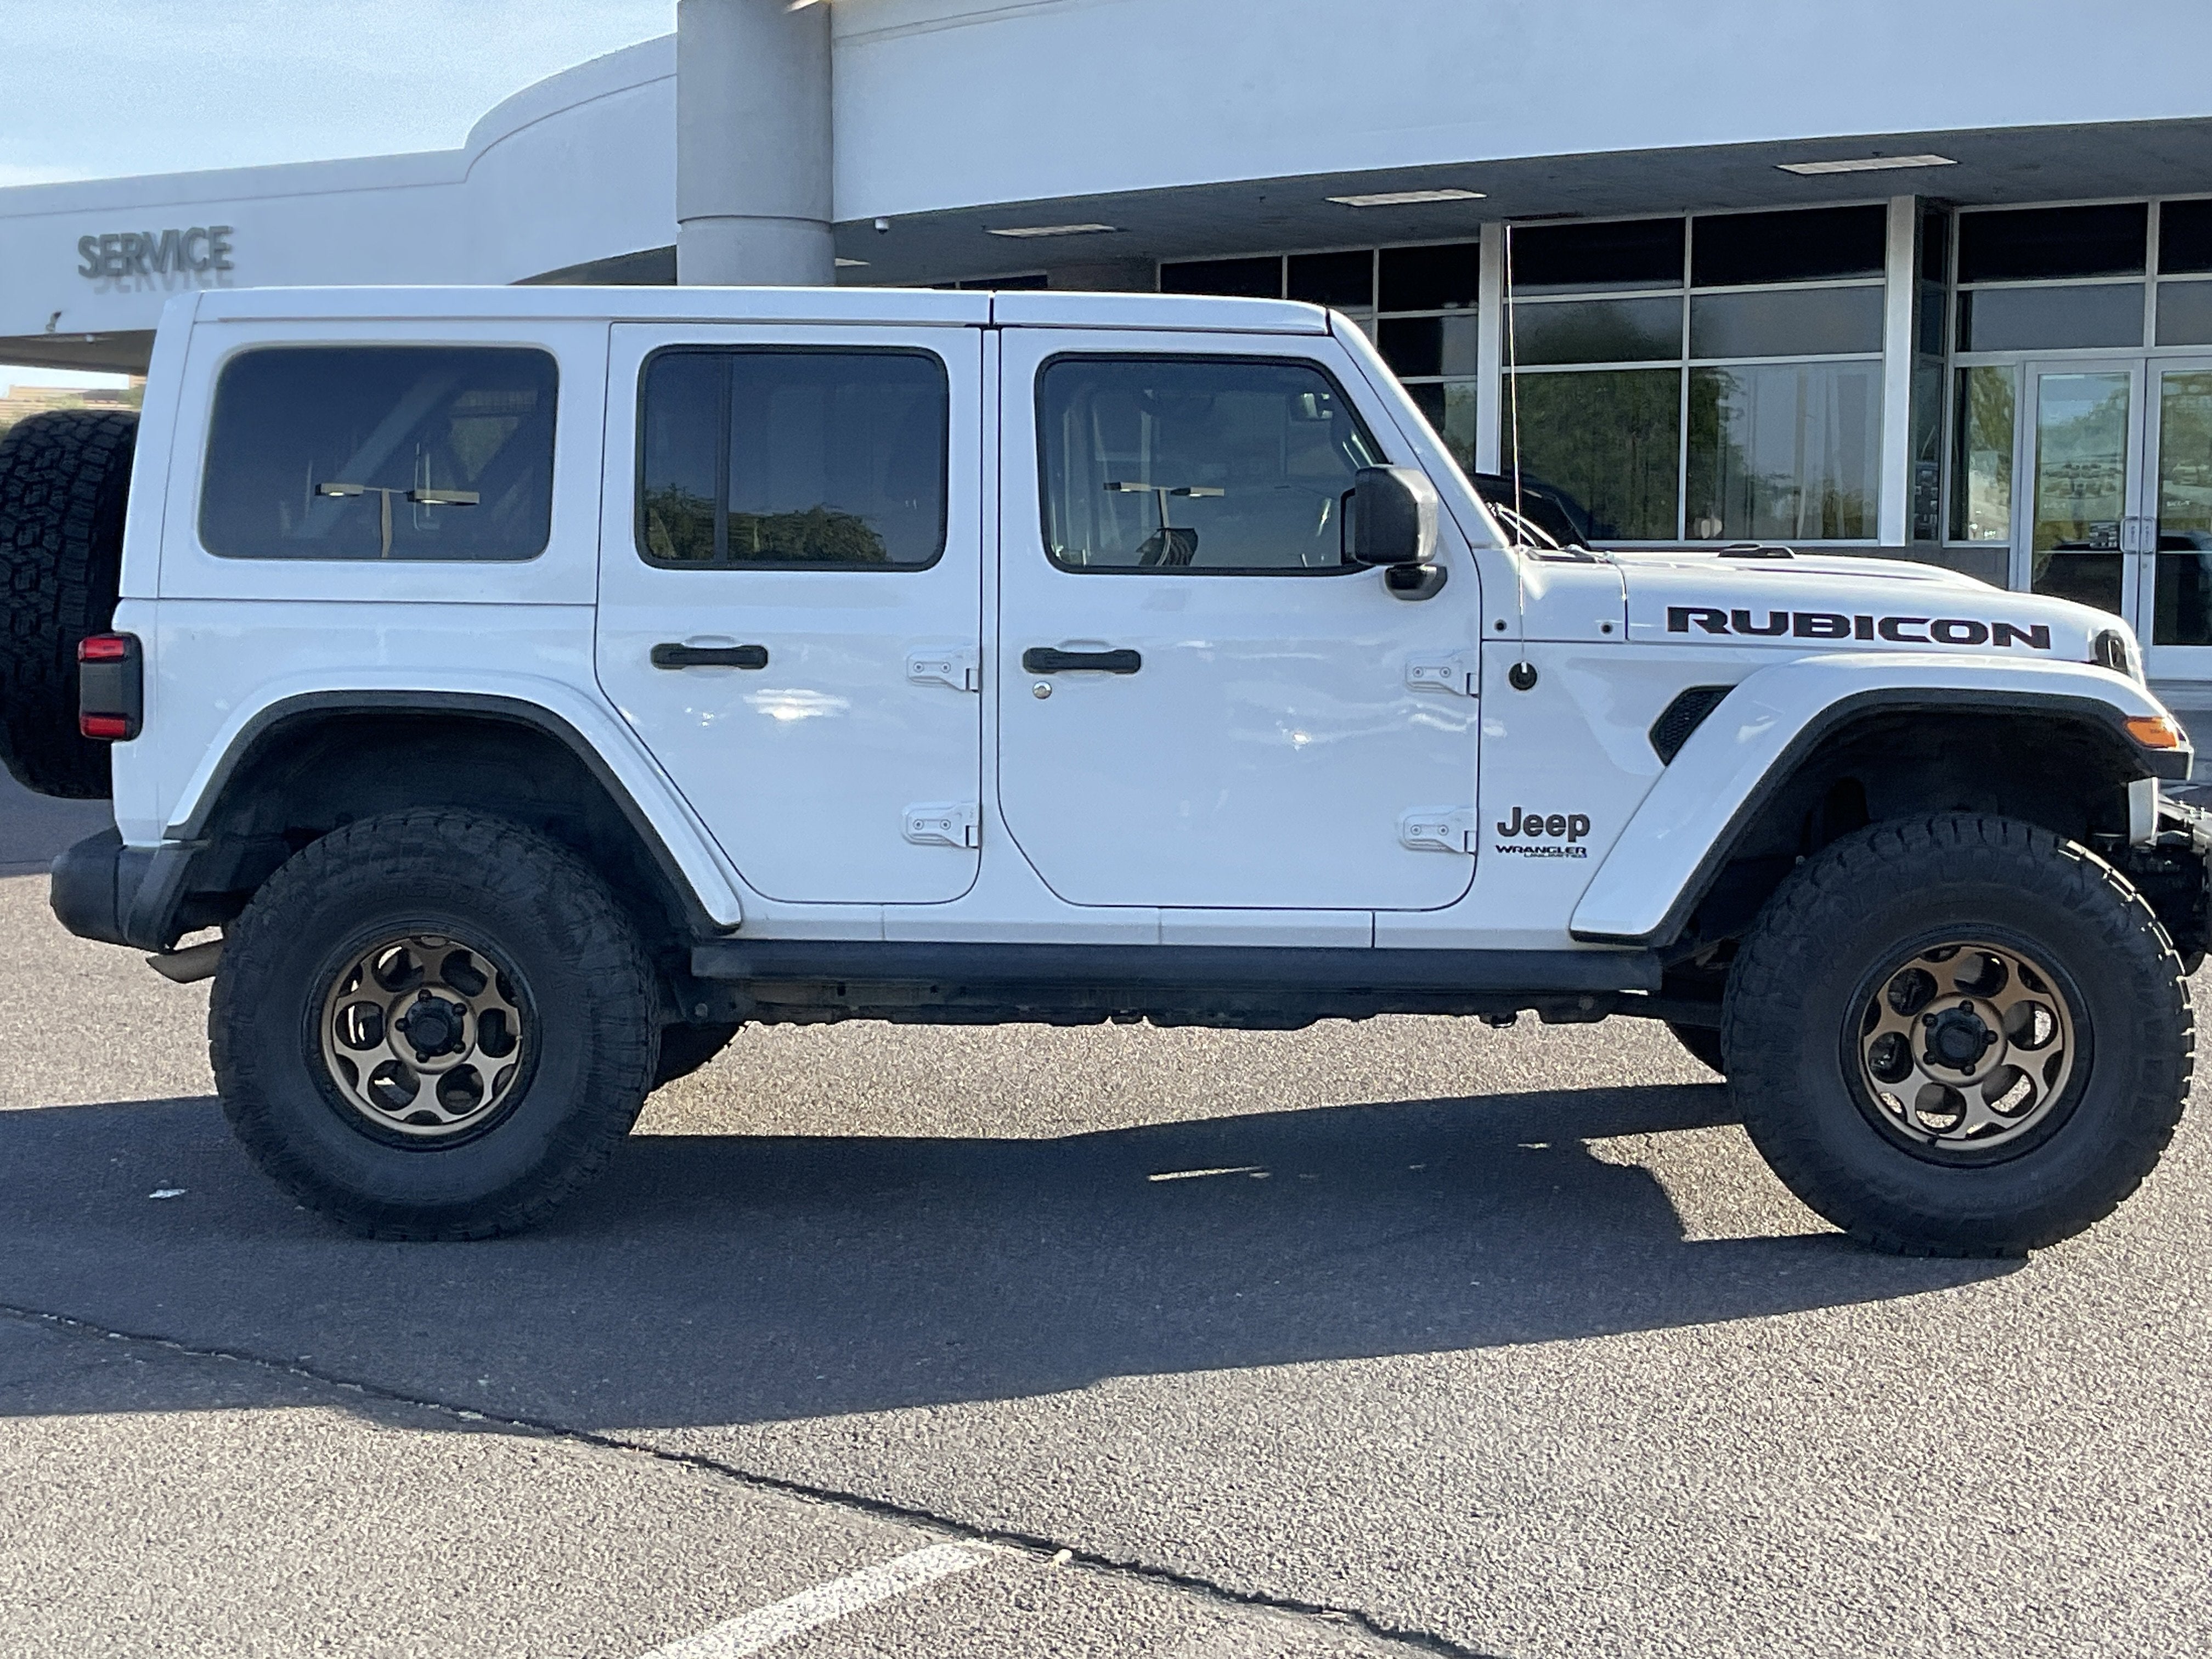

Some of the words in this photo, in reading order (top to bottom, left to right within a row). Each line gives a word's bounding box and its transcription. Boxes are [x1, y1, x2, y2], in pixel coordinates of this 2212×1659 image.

[78, 225, 234, 278] SERVICE
[1667, 607, 2051, 649] RUBICON
[1497, 807, 1590, 842] Jeep
[1495, 845, 1587, 853] WRANGLER
